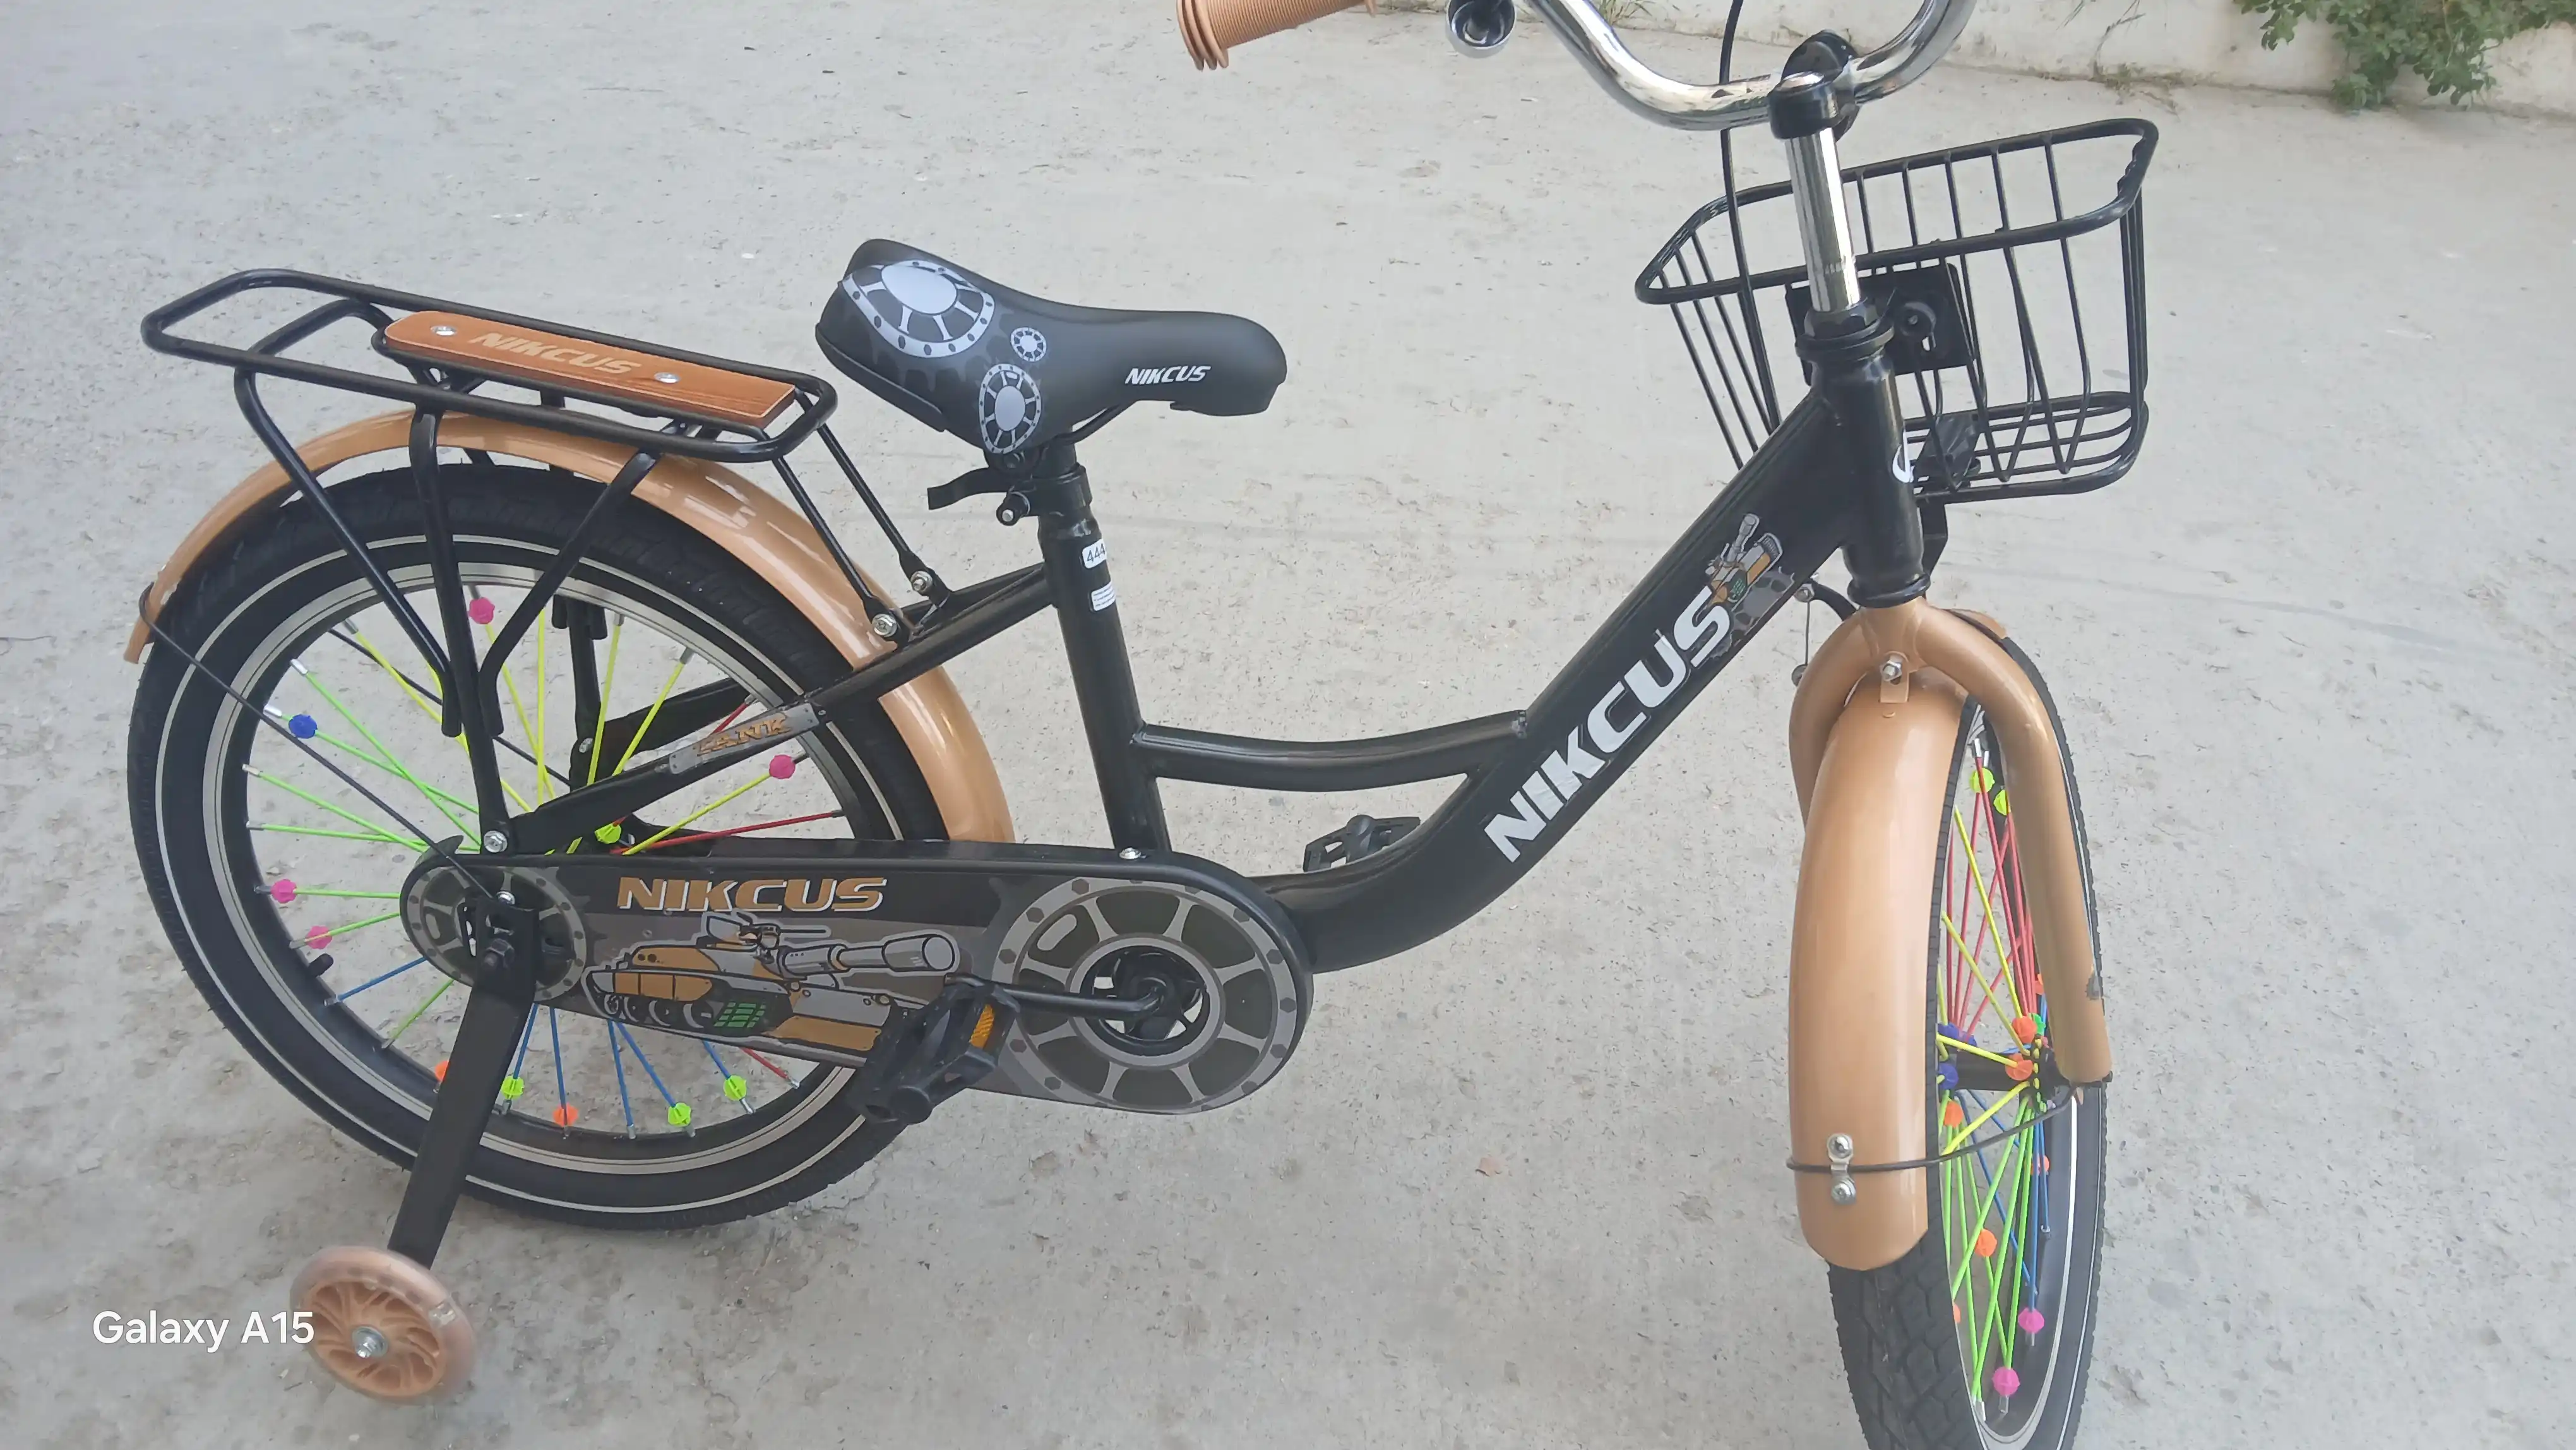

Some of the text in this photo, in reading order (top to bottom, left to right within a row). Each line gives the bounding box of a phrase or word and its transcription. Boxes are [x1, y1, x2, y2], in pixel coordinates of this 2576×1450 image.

[469, 332, 642, 375] NIKCUS
[1124, 365, 1212, 385] NIKCUS
[1484, 585, 1732, 863] NIKCUS
[617, 876, 888, 913] NIKCUS
